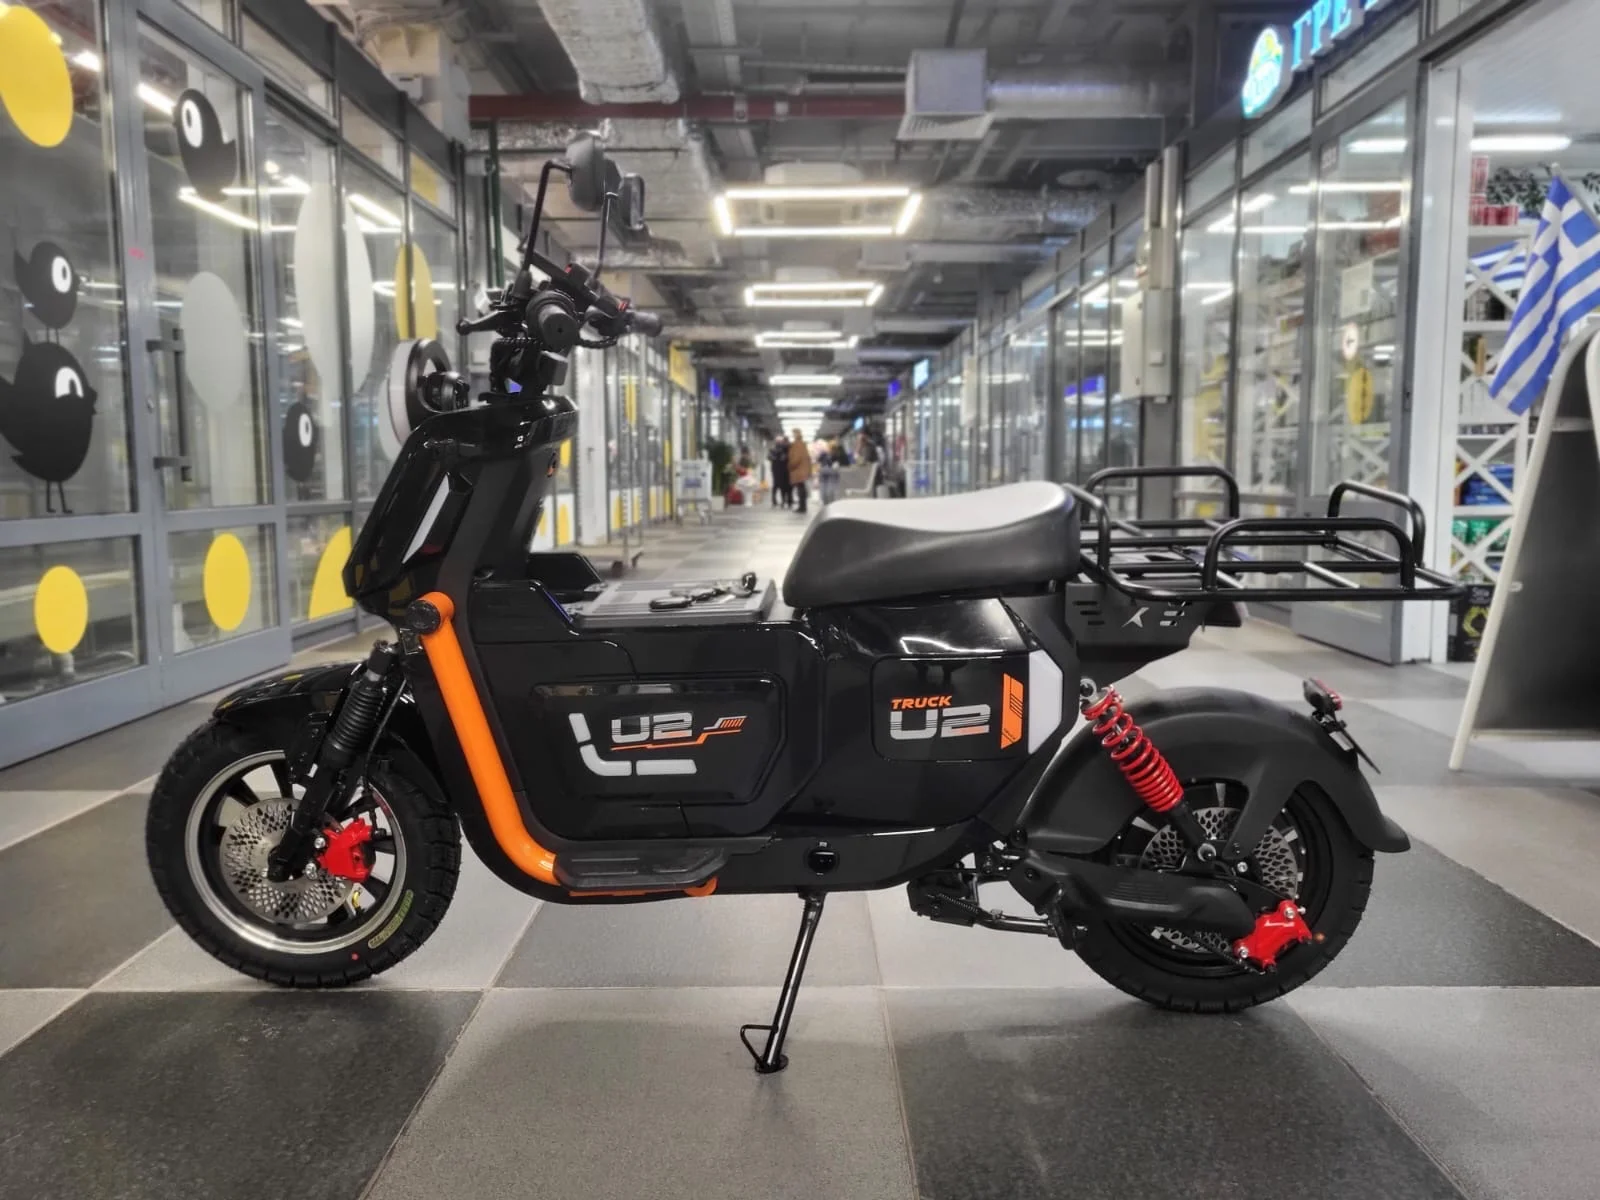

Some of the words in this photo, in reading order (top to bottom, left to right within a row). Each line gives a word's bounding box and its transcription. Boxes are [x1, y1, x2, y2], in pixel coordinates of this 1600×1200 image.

[1291, 0, 1378, 70] ГРЕ
[891, 695, 953, 710] TRUCK
[611, 712, 693, 744] U2
[890, 704, 991, 740] U2
